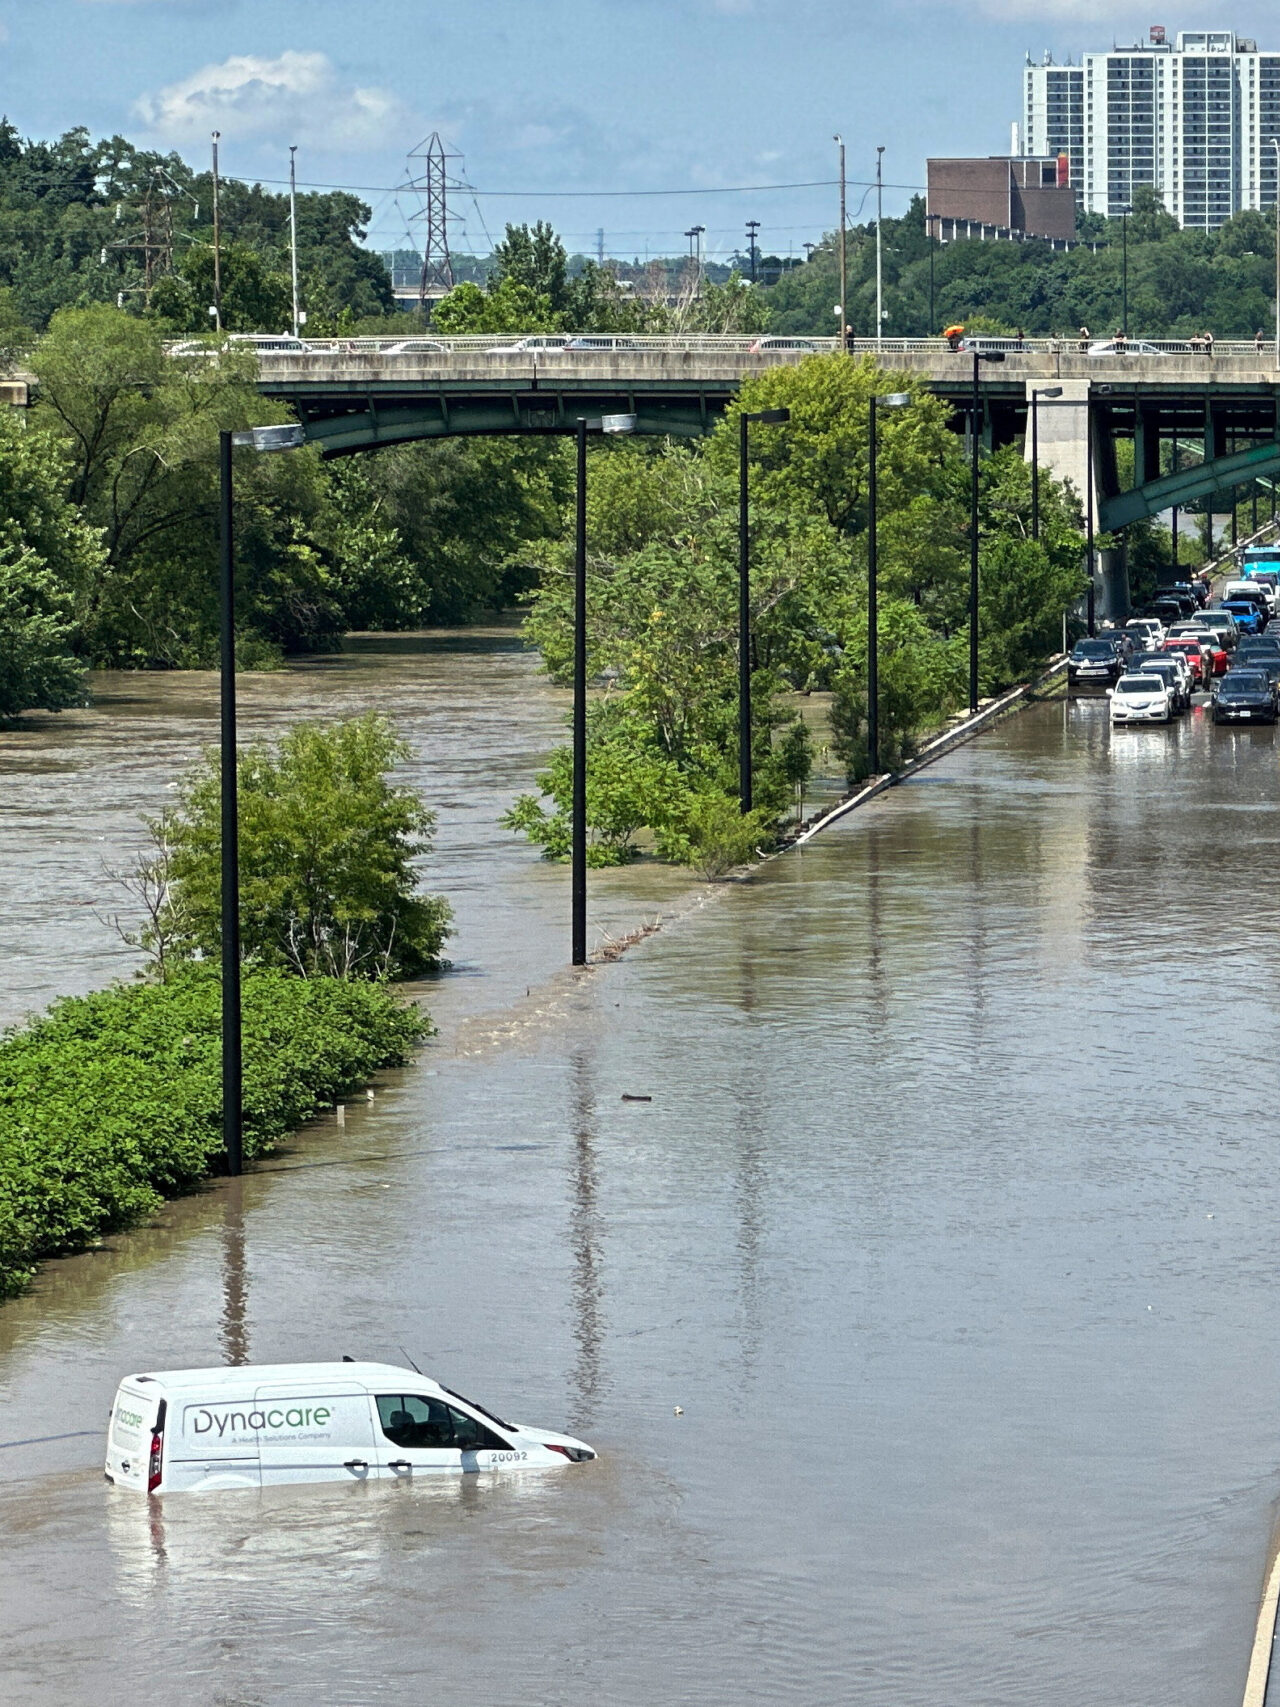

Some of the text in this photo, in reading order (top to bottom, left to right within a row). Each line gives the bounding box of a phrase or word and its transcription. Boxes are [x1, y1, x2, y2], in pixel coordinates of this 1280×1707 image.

[194, 1407, 331, 1437] Dynacare
[264, 1433, 297, 1442] Solutions
[298, 1432, 331, 1441] Company
[491, 1451, 528, 1463] 20092
